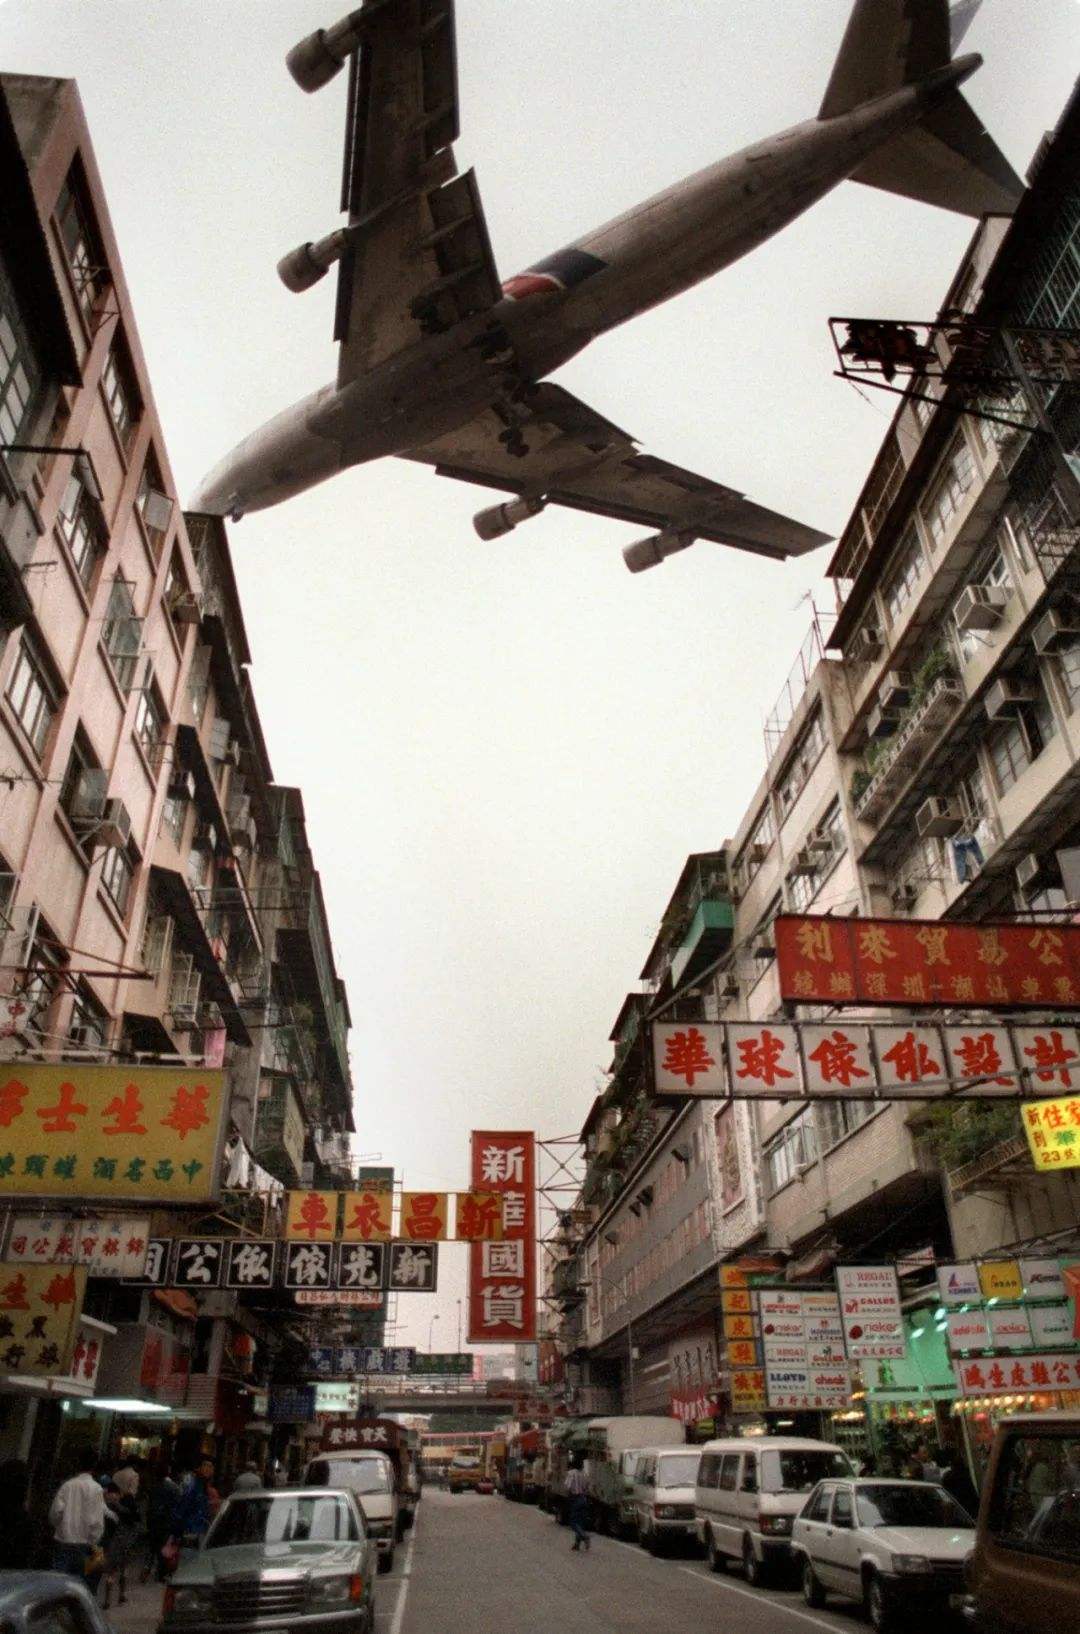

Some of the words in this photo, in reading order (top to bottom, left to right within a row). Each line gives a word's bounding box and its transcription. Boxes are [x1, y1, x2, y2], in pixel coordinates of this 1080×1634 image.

[661, 1027, 1078, 1087] 華球傢俬設計
[292, 1193, 501, 1241] 新昌衣車
[770, 1373, 807, 1382] LLOYD
